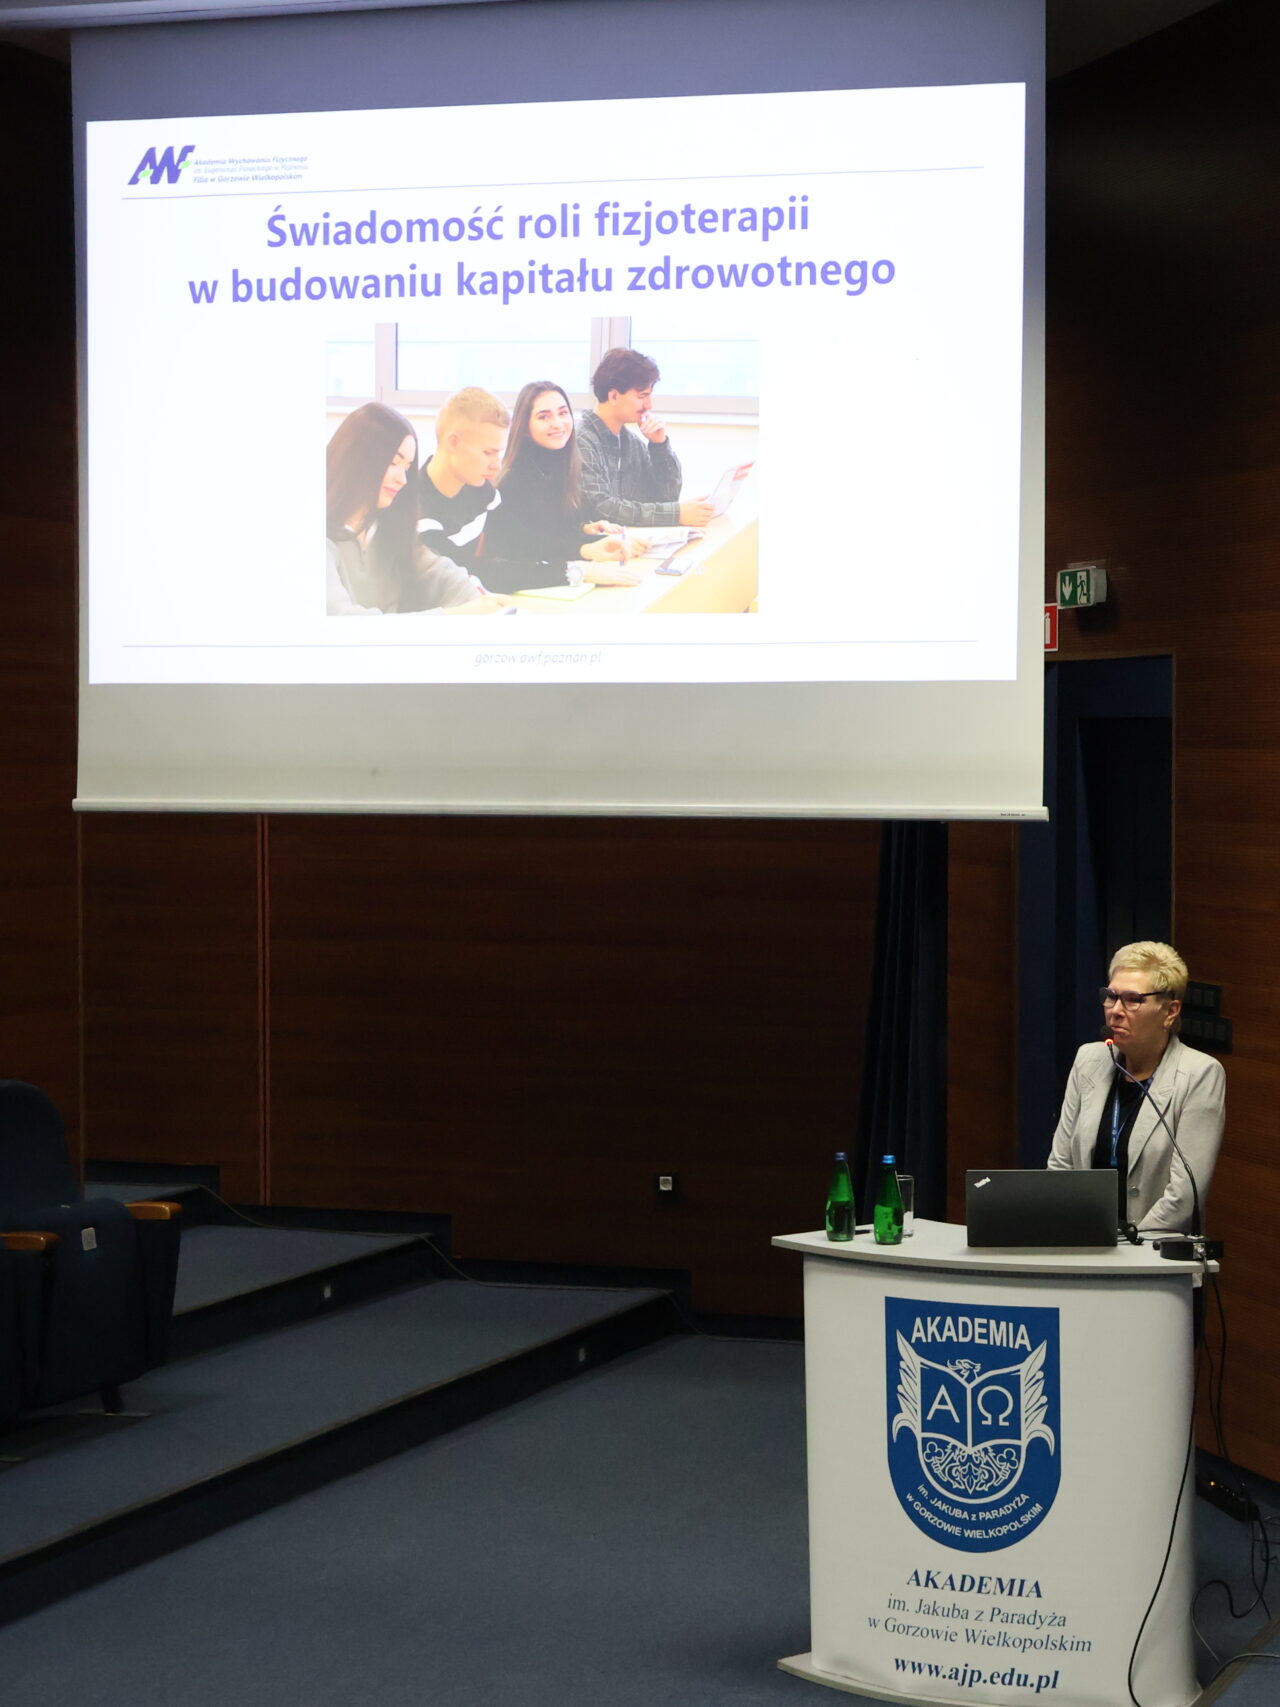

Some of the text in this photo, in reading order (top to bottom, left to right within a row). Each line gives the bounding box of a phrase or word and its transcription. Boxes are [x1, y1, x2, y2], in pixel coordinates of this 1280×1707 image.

[267, 195, 809, 248] Świadomość roli fizjoterapii
[188, 255, 896, 305] w budowaniu kapitału zdrowotnego
[911, 1315, 1032, 1351] AKADEMIA
[976, 1385, 1014, 1426] Ω
[905, 1492, 1043, 1539] w GORZOWIE WIELKOPOLSKIM
[917, 1483, 1030, 1521] im. JAKUBA z PARADYŻA
[906, 1568, 1043, 1598] AKADEMIA
[887, 1593, 1066, 1630] im. Jakuba z Paradyża
[868, 1616, 1092, 1653] w Gorzowie Wielkopolskim
[894, 1657, 1060, 1694] www.ajp.edu.pl
